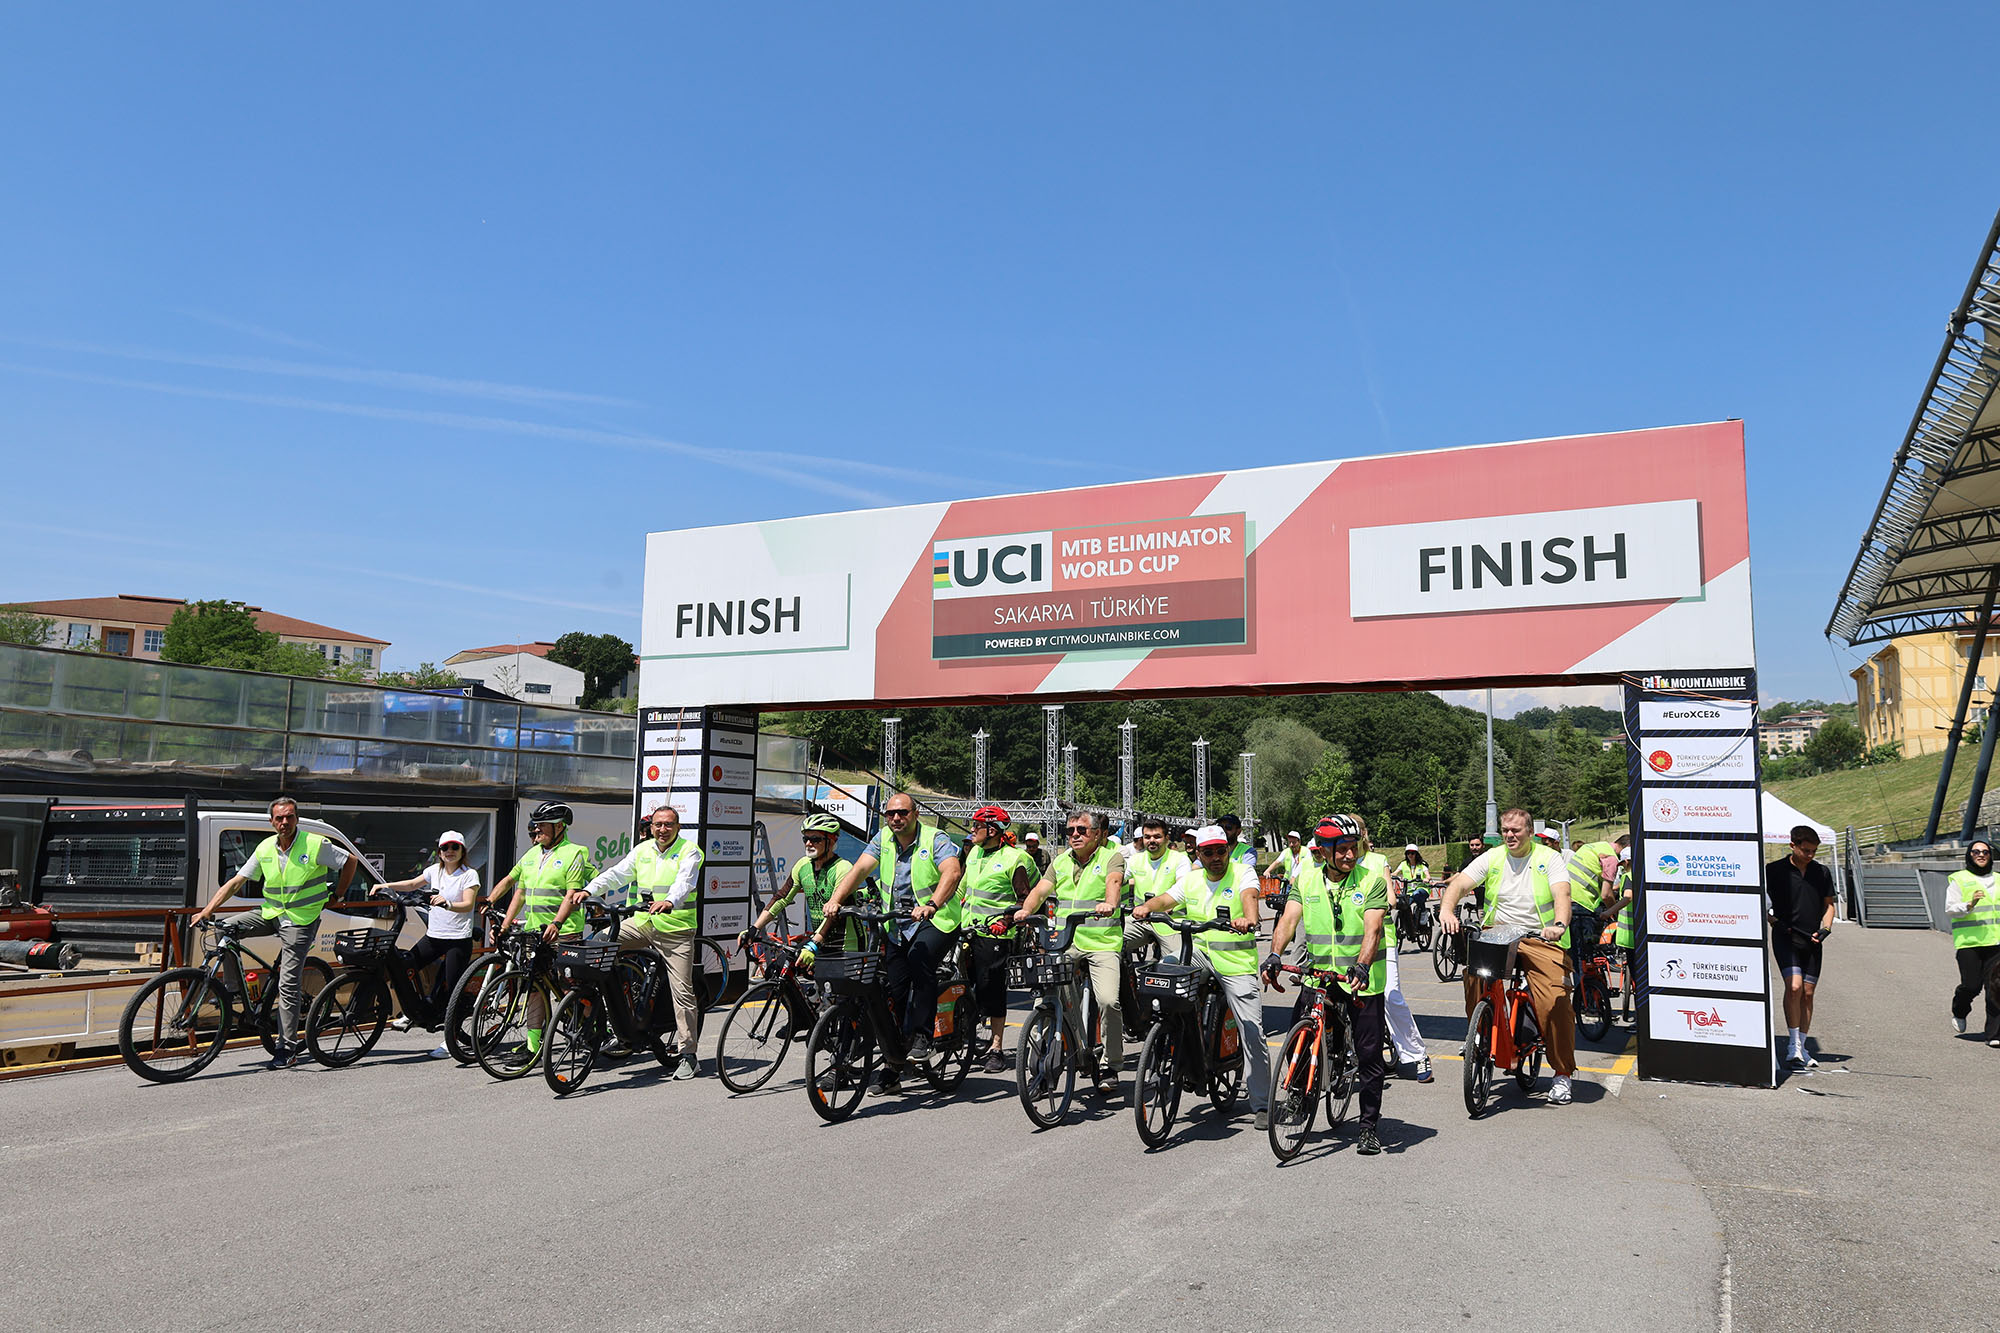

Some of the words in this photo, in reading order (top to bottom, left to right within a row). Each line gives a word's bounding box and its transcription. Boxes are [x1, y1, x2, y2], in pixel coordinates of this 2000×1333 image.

[1061, 539, 1102, 557] MTB
[1108, 526, 1232, 551] ELIMINATOR
[954, 543, 1042, 587] UCI
[1061, 560, 1133, 580] WORLD
[1139, 554, 1180, 574] CUP
[1419, 532, 1627, 593] FINISH
[676, 595, 801, 639] FINISH
[994, 603, 1074, 625] SAKARYA
[1090, 594, 1169, 619] TÜRKİYE
[985, 637, 1032, 649] POWERED
[1035, 636, 1048, 647] BY
[1049, 629, 1180, 646] CITYMOUNTAINBIKE.COM
[1671, 676, 1746, 689] MOUNTAINBIKE
[1663, 710, 1720, 719] #EuroXCE26
[1686, 862, 1741, 871] BÜYÜKŞEHİR
[1687, 869, 1736, 878] BELEDİYESİ
[1692, 961, 1719, 971] TÜRKİYE
[1720, 963, 1748, 973] BİSİKLET
[1693, 972, 1739, 982] FEDERASYONU
[1677, 1007, 1727, 1030] TGA
